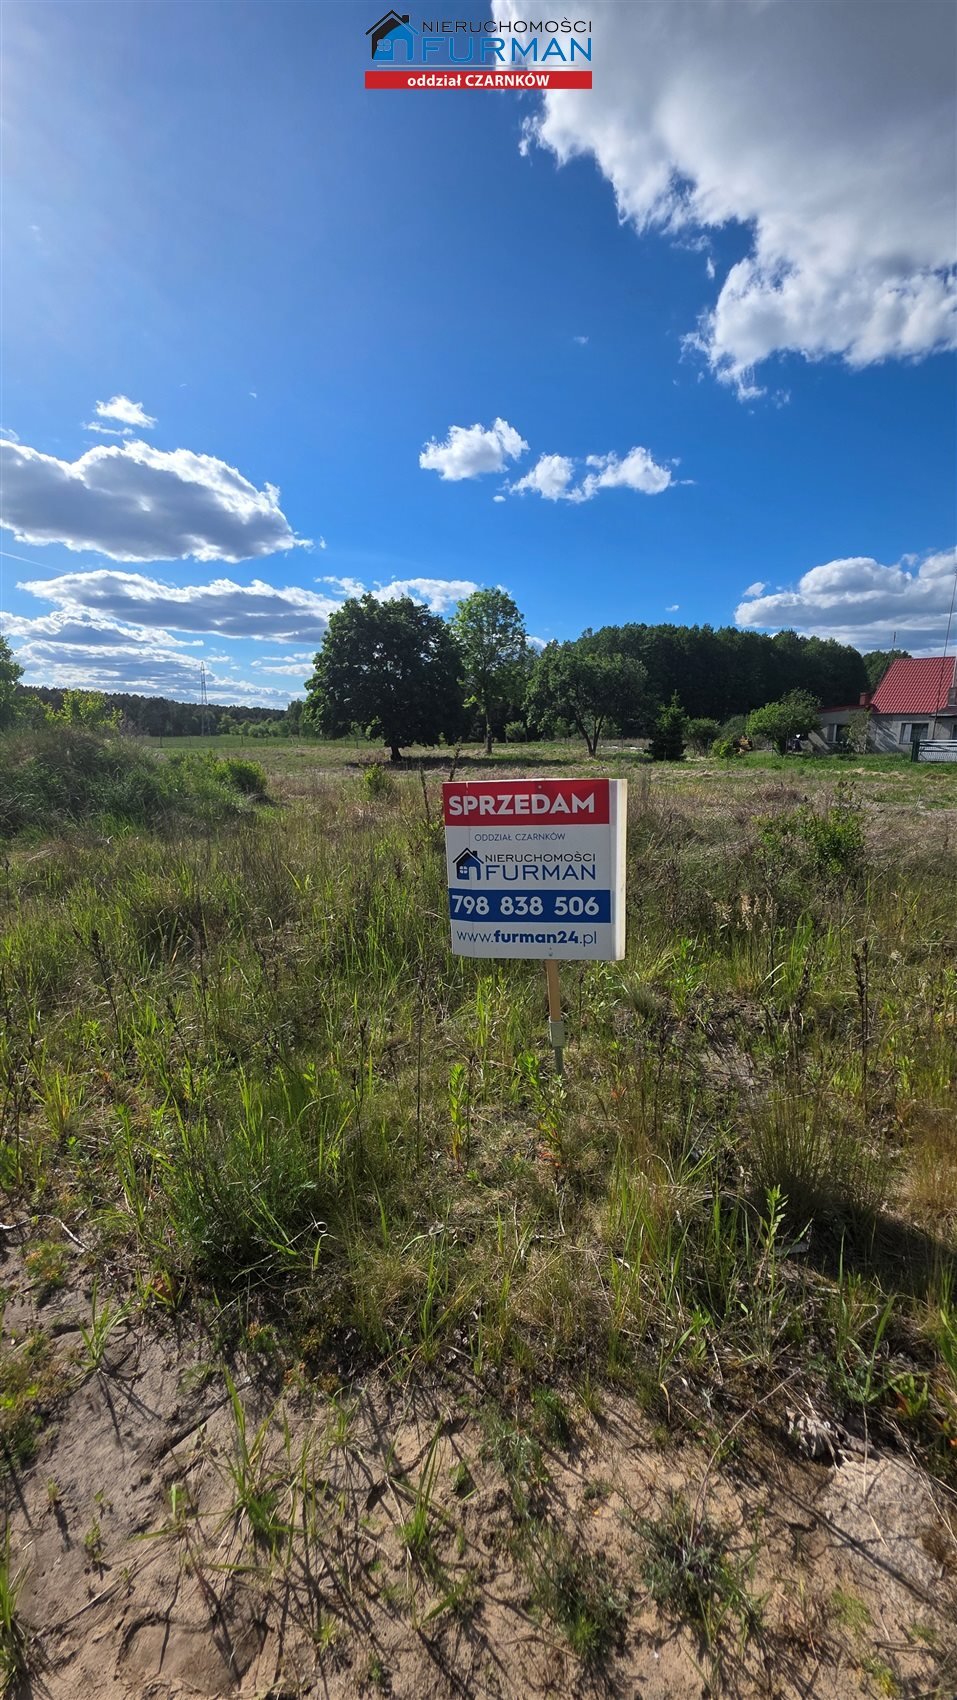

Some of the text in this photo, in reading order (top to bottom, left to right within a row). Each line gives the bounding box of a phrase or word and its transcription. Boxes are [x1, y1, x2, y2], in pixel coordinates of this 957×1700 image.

[449, 792, 595, 816] SPRZEDAM
[474, 832, 566, 842] ODDZIAŁ CZARNKÓW
[485, 864, 596, 881] FURMAN
[451, 895, 600, 916] 798 838 506
[456, 930, 597, 947] www.furman24.pl
